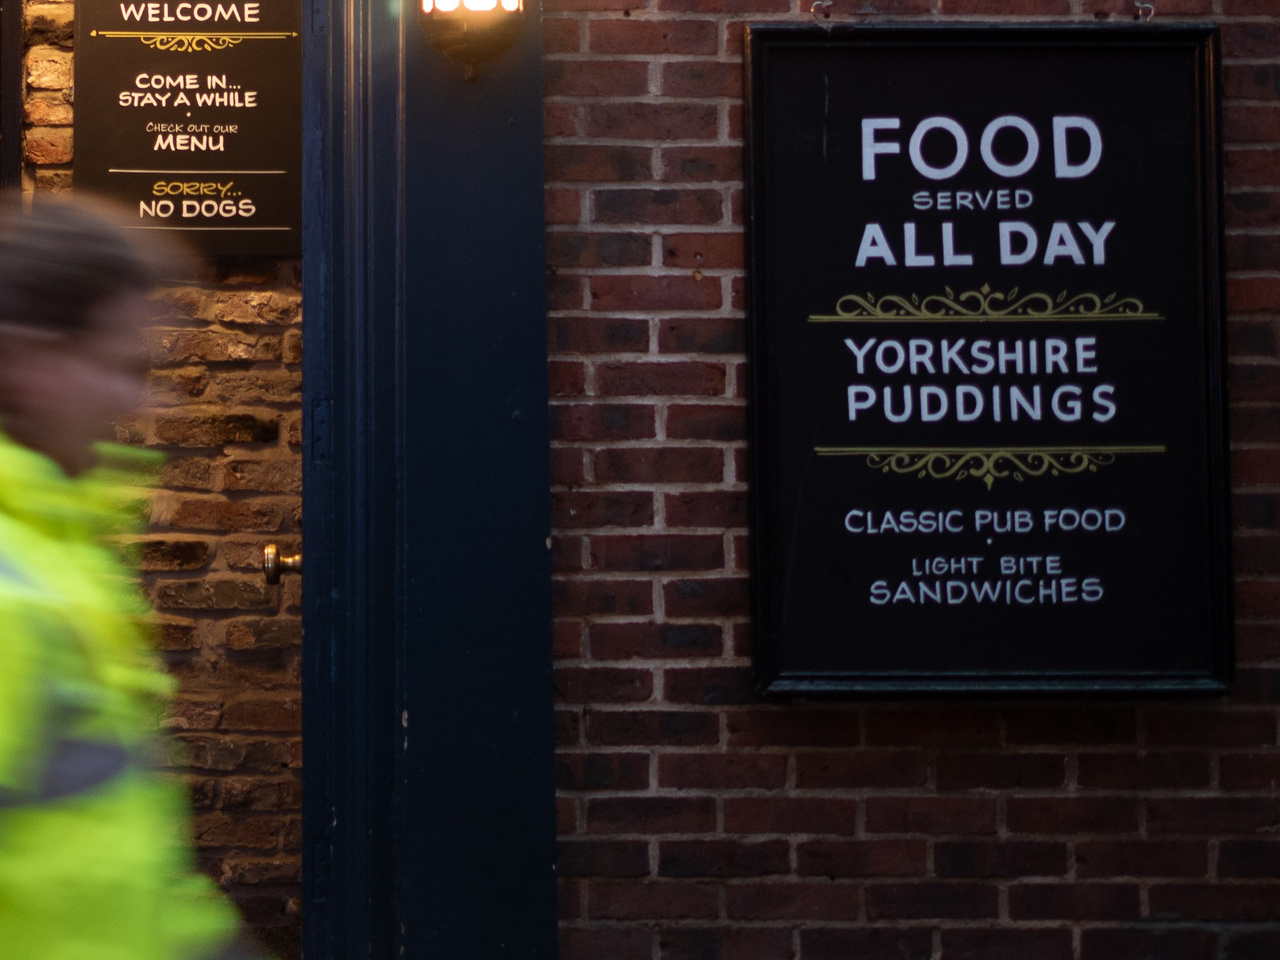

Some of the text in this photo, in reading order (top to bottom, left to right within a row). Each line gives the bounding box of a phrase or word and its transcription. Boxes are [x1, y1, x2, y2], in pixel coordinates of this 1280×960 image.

[119, 2, 260, 23] WELCOME
[134, 72, 200, 90] COME
[118, 91, 258, 108] STAY A WHILE
[145, 121, 239, 134] CHECK OUT OUR
[153, 133, 225, 152] MENU
[861, 114, 1103, 181] FOOD
[139, 198, 256, 219] NO DOGS
[912, 188, 1034, 211] SERVED
[854, 220, 1116, 268] ALL DAY
[843, 336, 1098, 375] YORKSHIRE
[847, 383, 1117, 423] PUDDINGS
[844, 508, 1126, 534] CLASSIC PUB FOOD
[911, 555, 1062, 577] LIGHT BITE
[869, 577, 1104, 605] SANDWICHES
